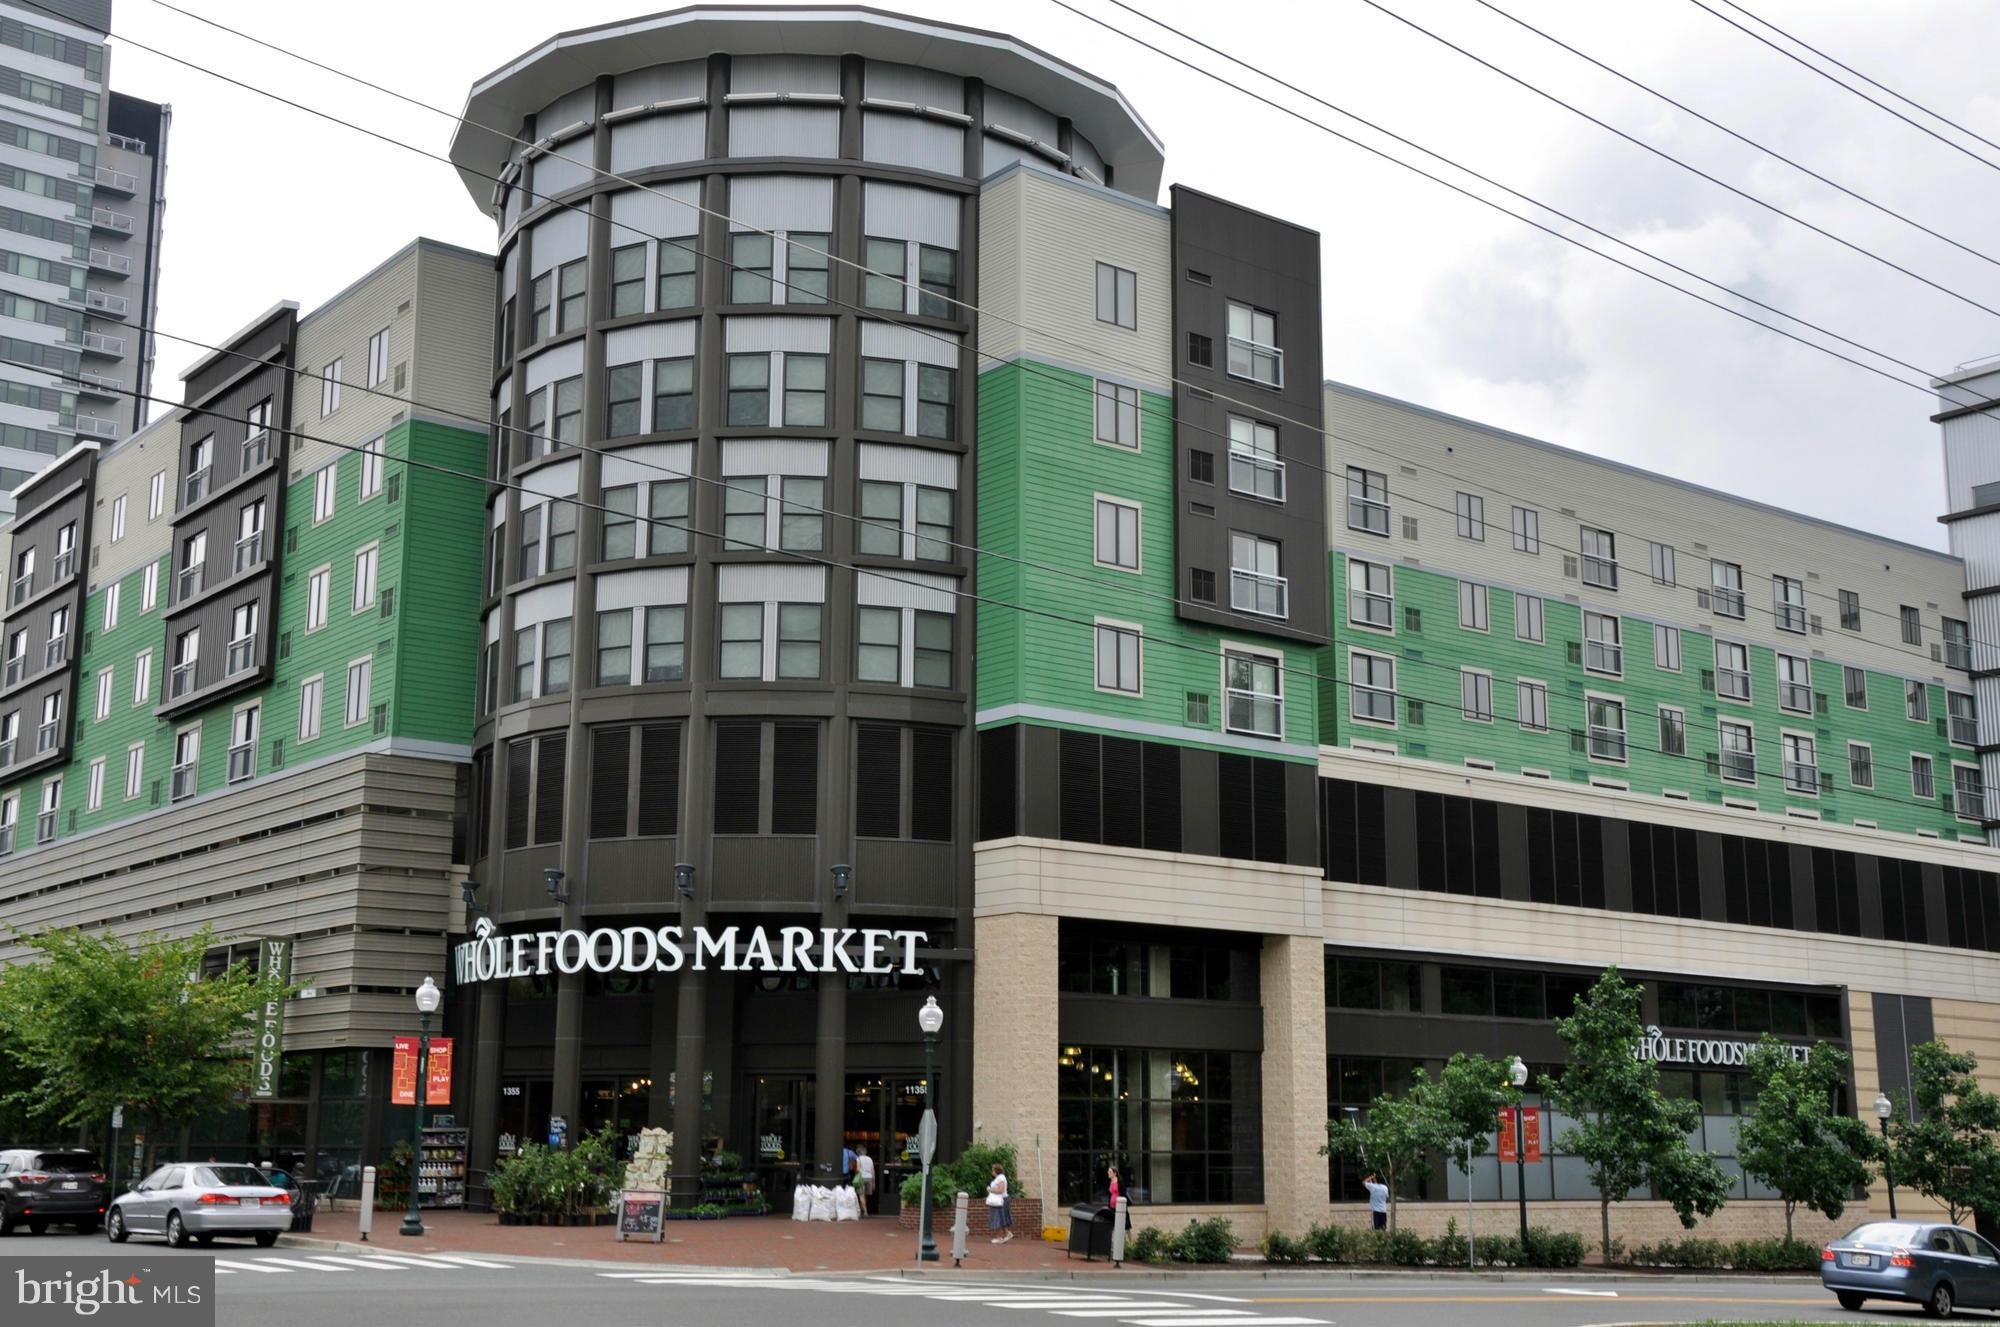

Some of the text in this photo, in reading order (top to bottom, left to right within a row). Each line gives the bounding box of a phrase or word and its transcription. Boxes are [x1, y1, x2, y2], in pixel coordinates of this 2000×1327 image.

[455, 917, 535, 985] WHOLE
[536, 926, 684, 974] FOODS
[692, 925, 928, 975] MARKET
[1688, 1040, 1745, 1066] FOODS
